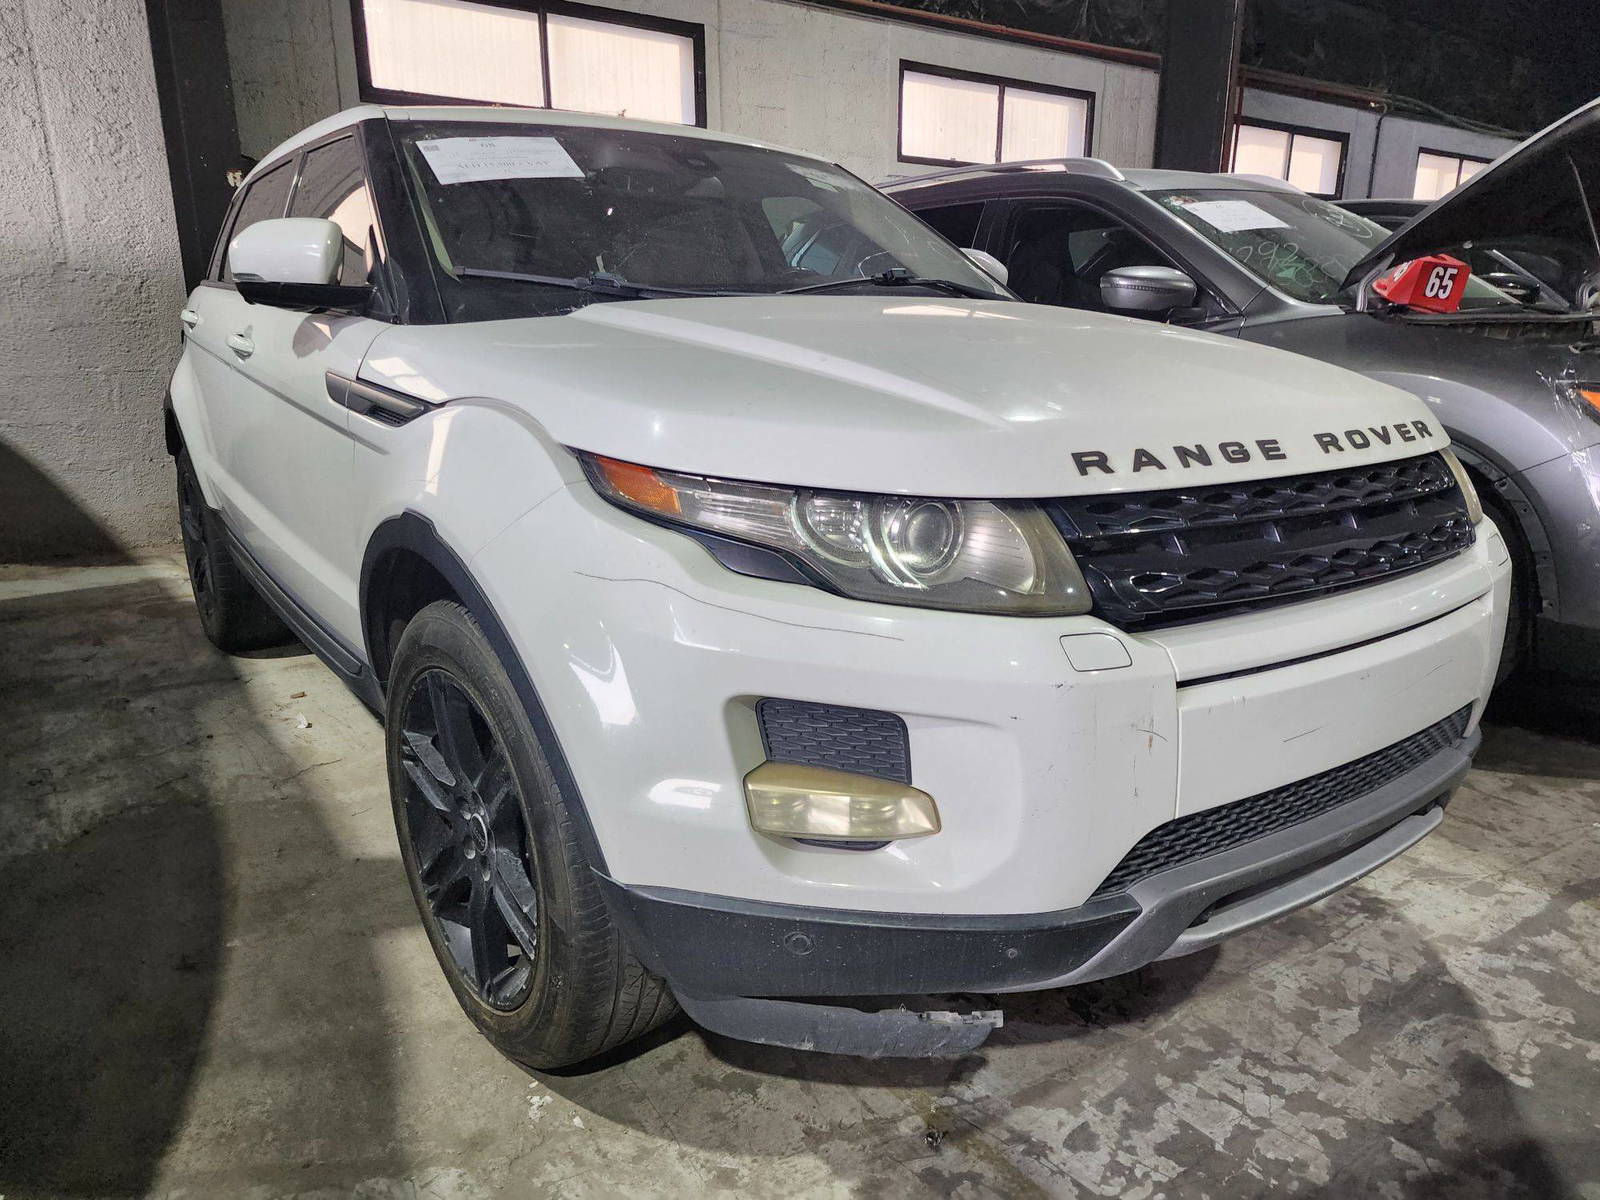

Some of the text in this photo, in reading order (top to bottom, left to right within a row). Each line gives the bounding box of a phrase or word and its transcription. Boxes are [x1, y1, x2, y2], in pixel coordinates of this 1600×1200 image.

[1425, 266, 1458, 300] 65
[1071, 420, 1434, 476] RANGE ROVER
